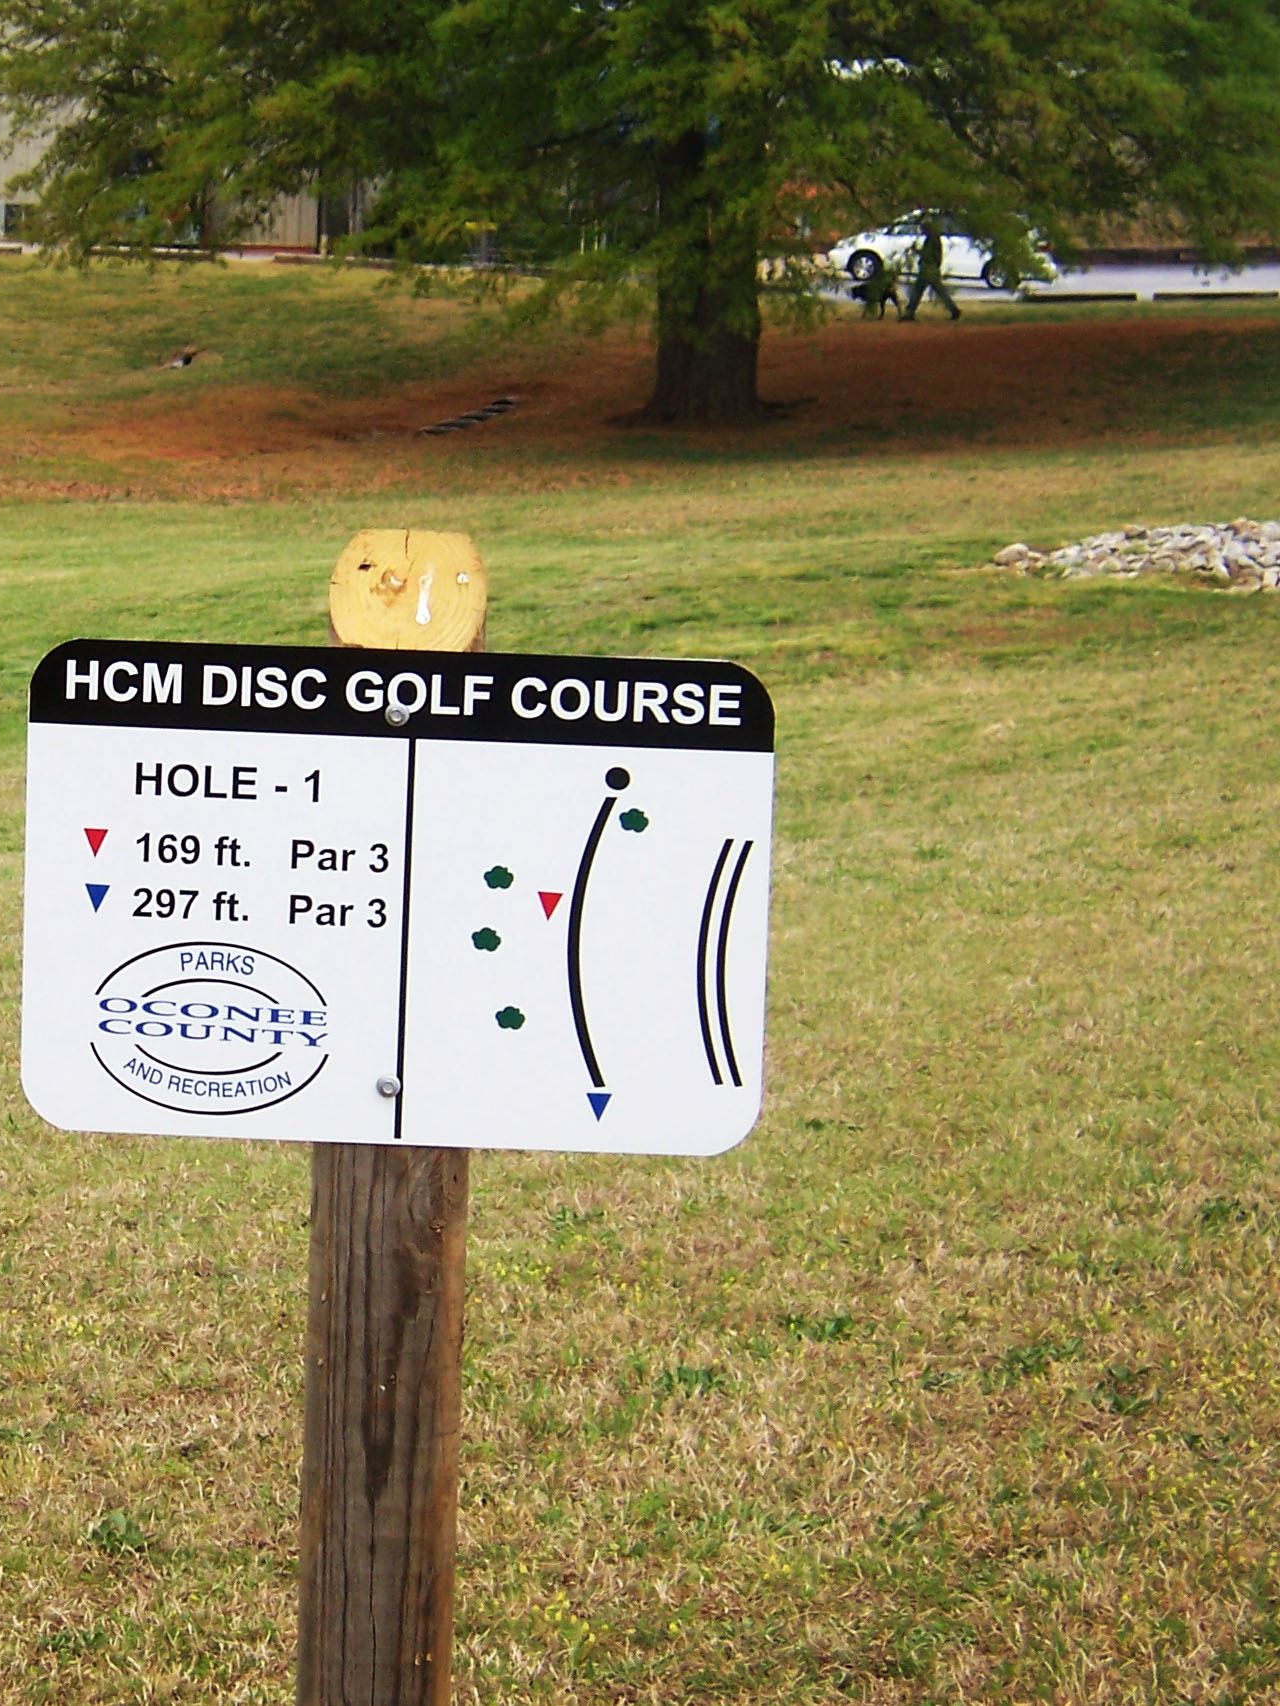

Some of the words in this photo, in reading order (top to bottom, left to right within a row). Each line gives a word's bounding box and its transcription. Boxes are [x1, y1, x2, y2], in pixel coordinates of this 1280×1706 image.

[65, 659, 183, 705] HCM
[202, 664, 328, 711] DISC
[346, 670, 494, 717] GOLF
[511, 676, 742, 727] COURSE
[134, 762, 258, 801] HOLE
[304, 769, 322, 803] 1
[135, 832, 201, 866] 169
[215, 835, 251, 868] ft.
[290, 839, 356, 871] Par
[370, 842, 390, 873] 3
[132, 888, 198, 921] 297
[212, 890, 249, 922] ft.
[288, 894, 354, 927] Par
[367, 898, 388, 928] 3
[179, 951, 255, 976] PARKS
[98, 997, 328, 1028] OCONEE
[98, 1018, 328, 1048] COUNTY
[122, 1057, 163, 1086] AND
[168, 1071, 292, 1099] RECREATION
